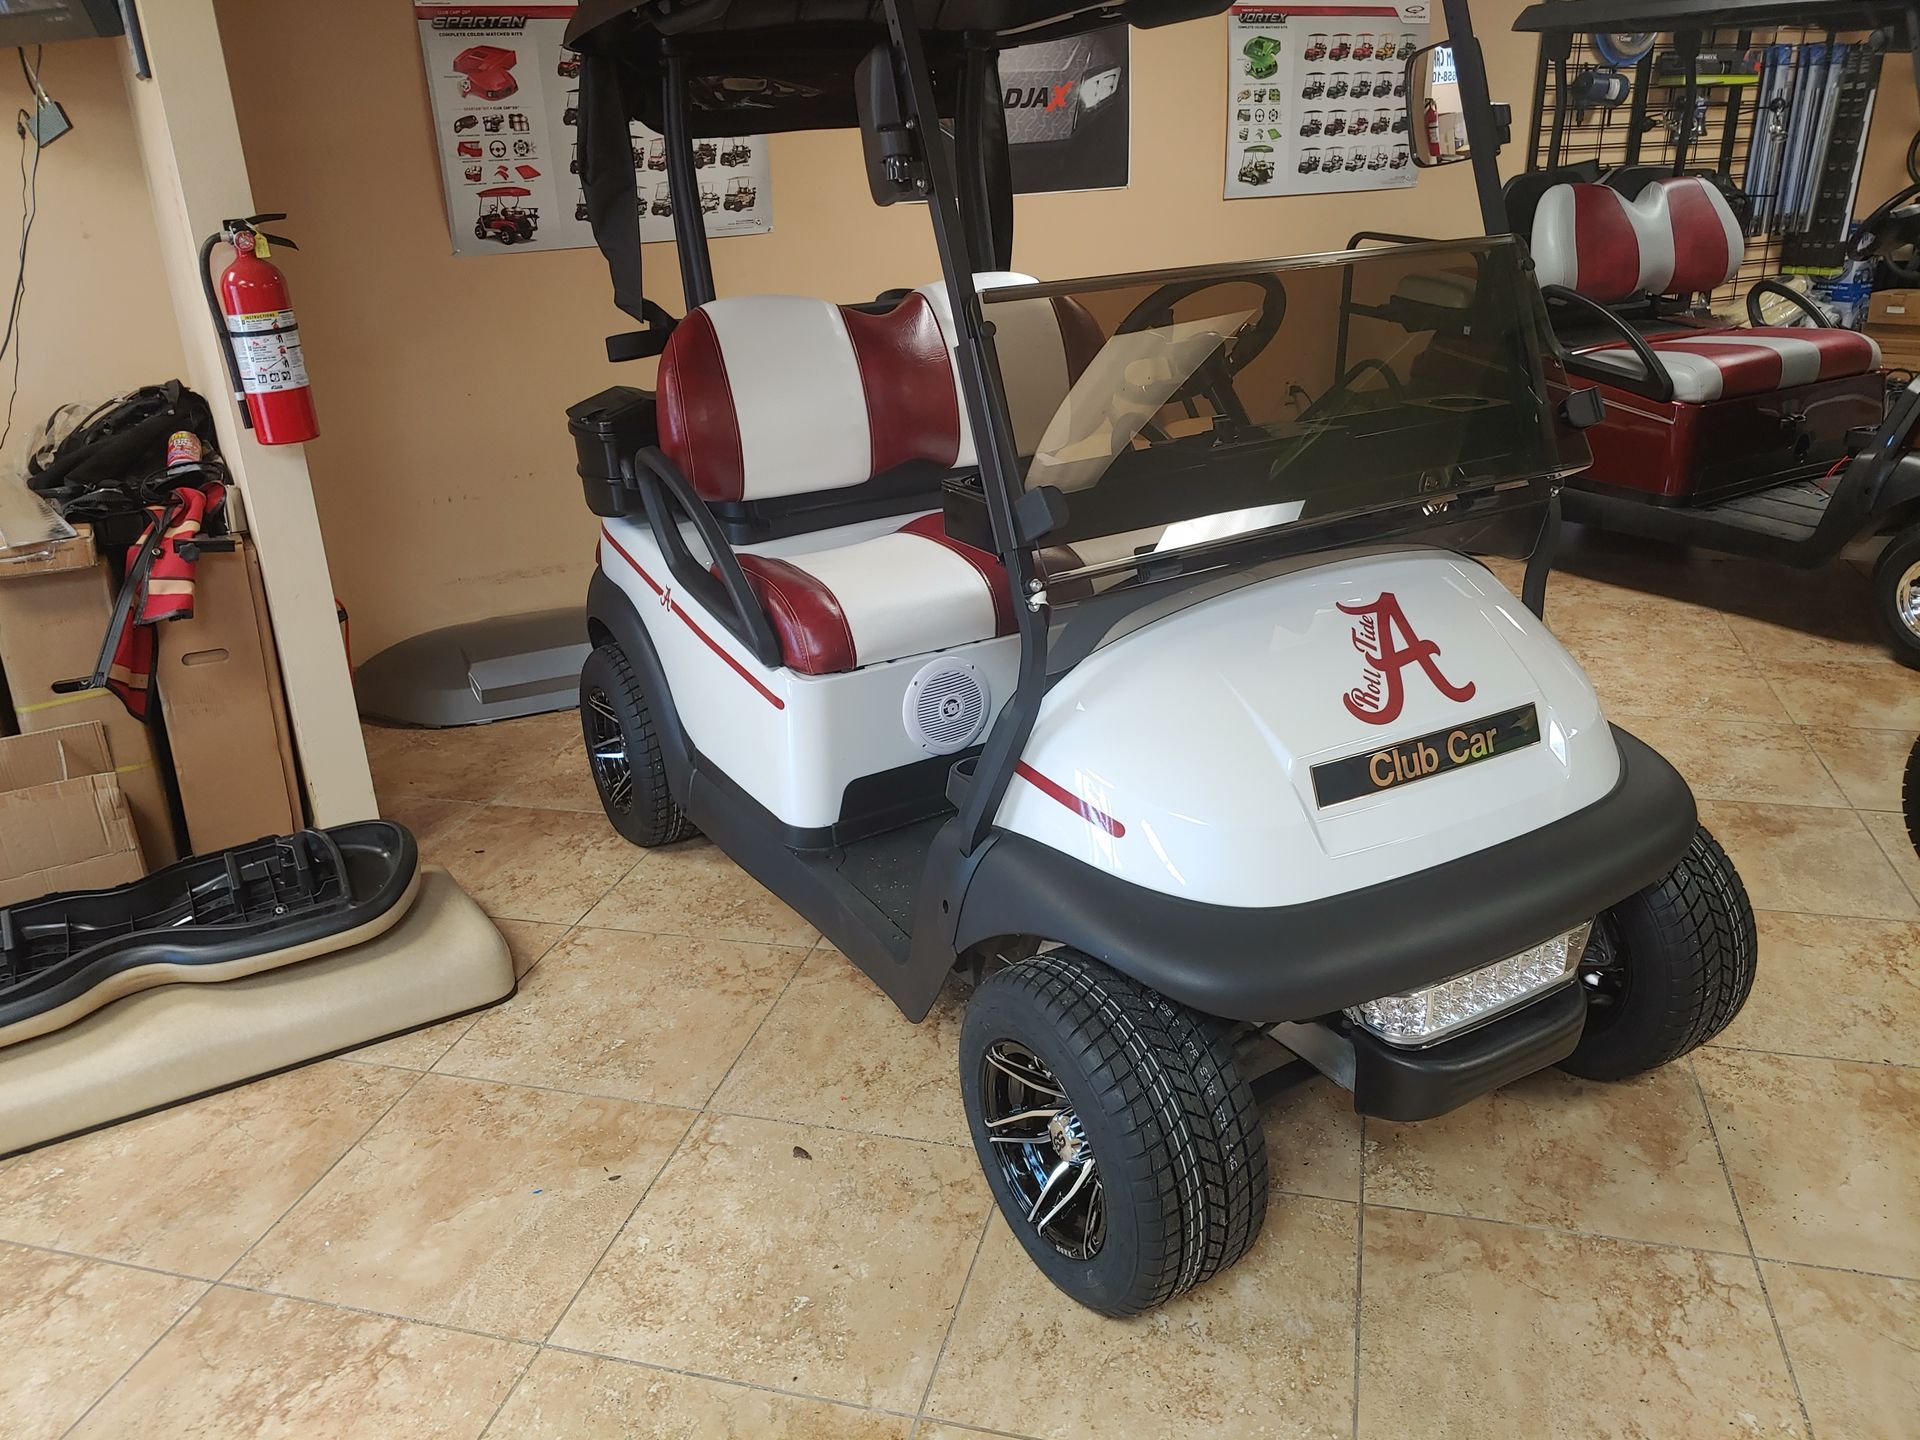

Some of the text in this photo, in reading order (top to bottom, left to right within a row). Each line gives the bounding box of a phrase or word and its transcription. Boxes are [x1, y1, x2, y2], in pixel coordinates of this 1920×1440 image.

[432, 15, 527, 29] SPARTAN
[1239, 13, 1288, 23] VORTEX
[1350, 614, 1382, 710] Roll Tide
[1369, 727, 1498, 788] Club Car
